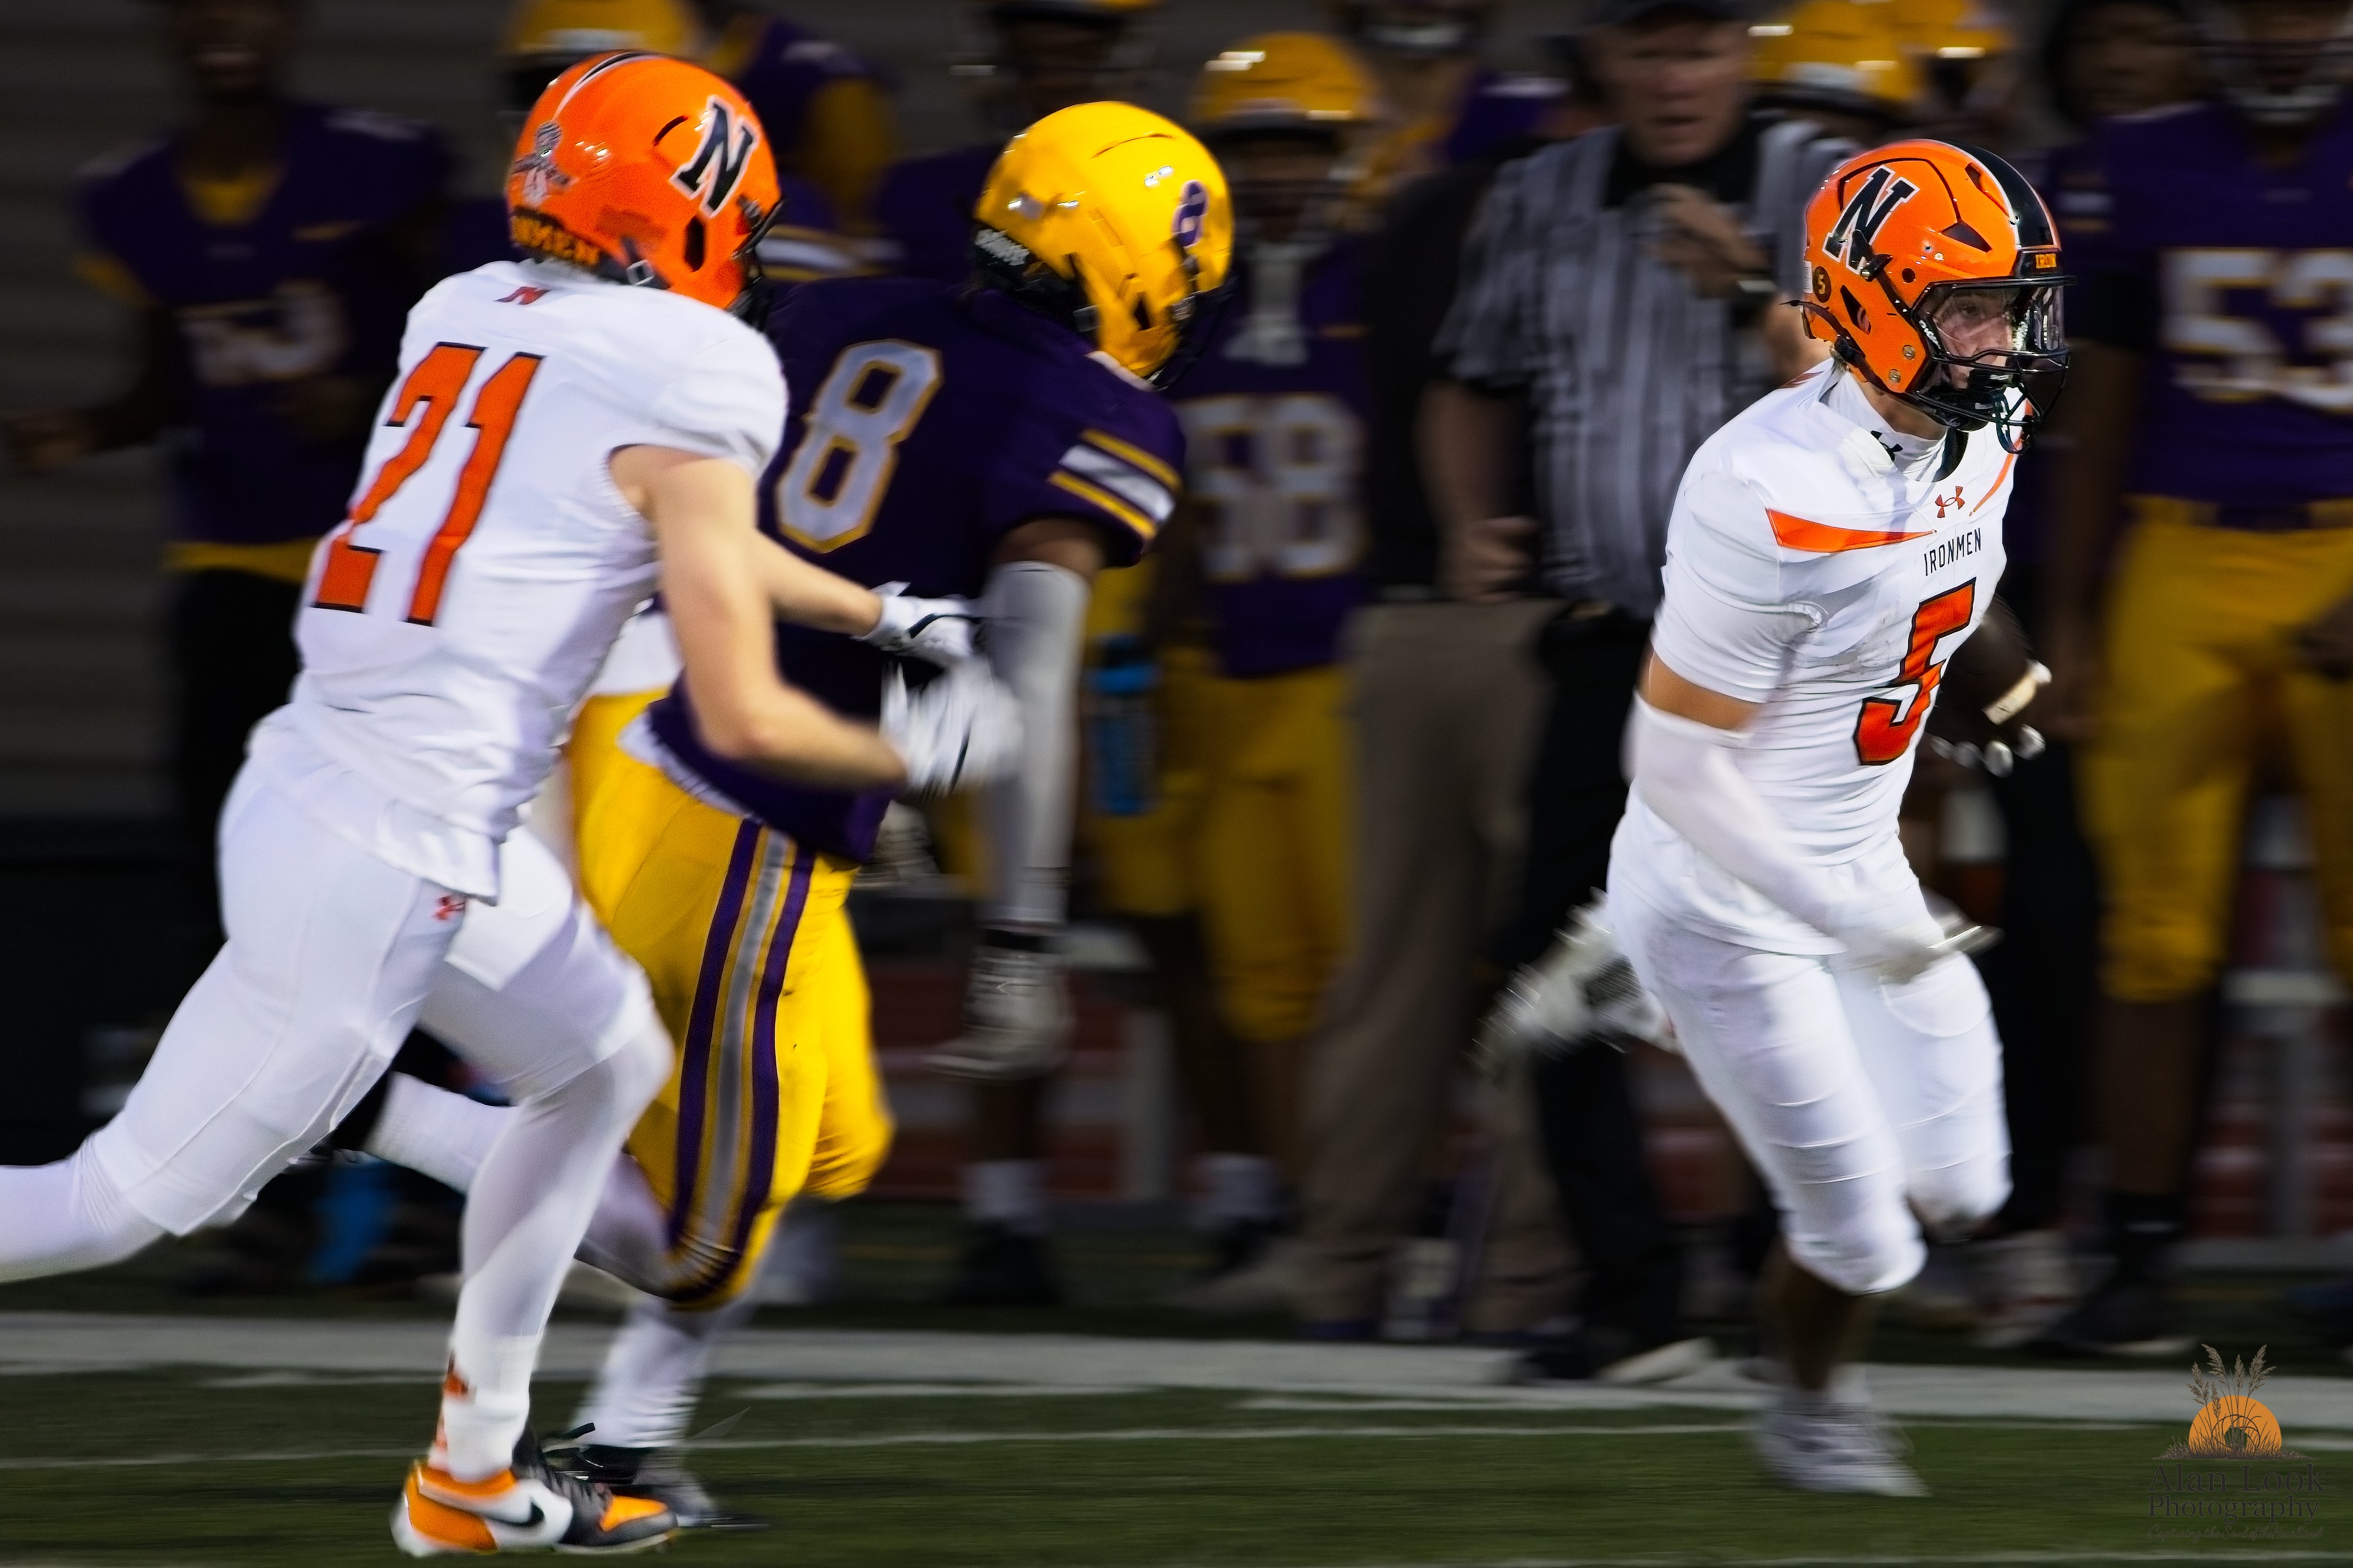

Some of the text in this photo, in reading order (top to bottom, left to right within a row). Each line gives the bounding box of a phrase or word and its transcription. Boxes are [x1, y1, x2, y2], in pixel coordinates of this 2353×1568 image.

[669, 95, 760, 218] N
[1822, 165, 1920, 275] N
[312, 341, 546, 627] 21
[775, 338, 945, 552] 8
[1923, 527, 1982, 577] IRONMEN
[1853, 576, 1977, 766] 5
